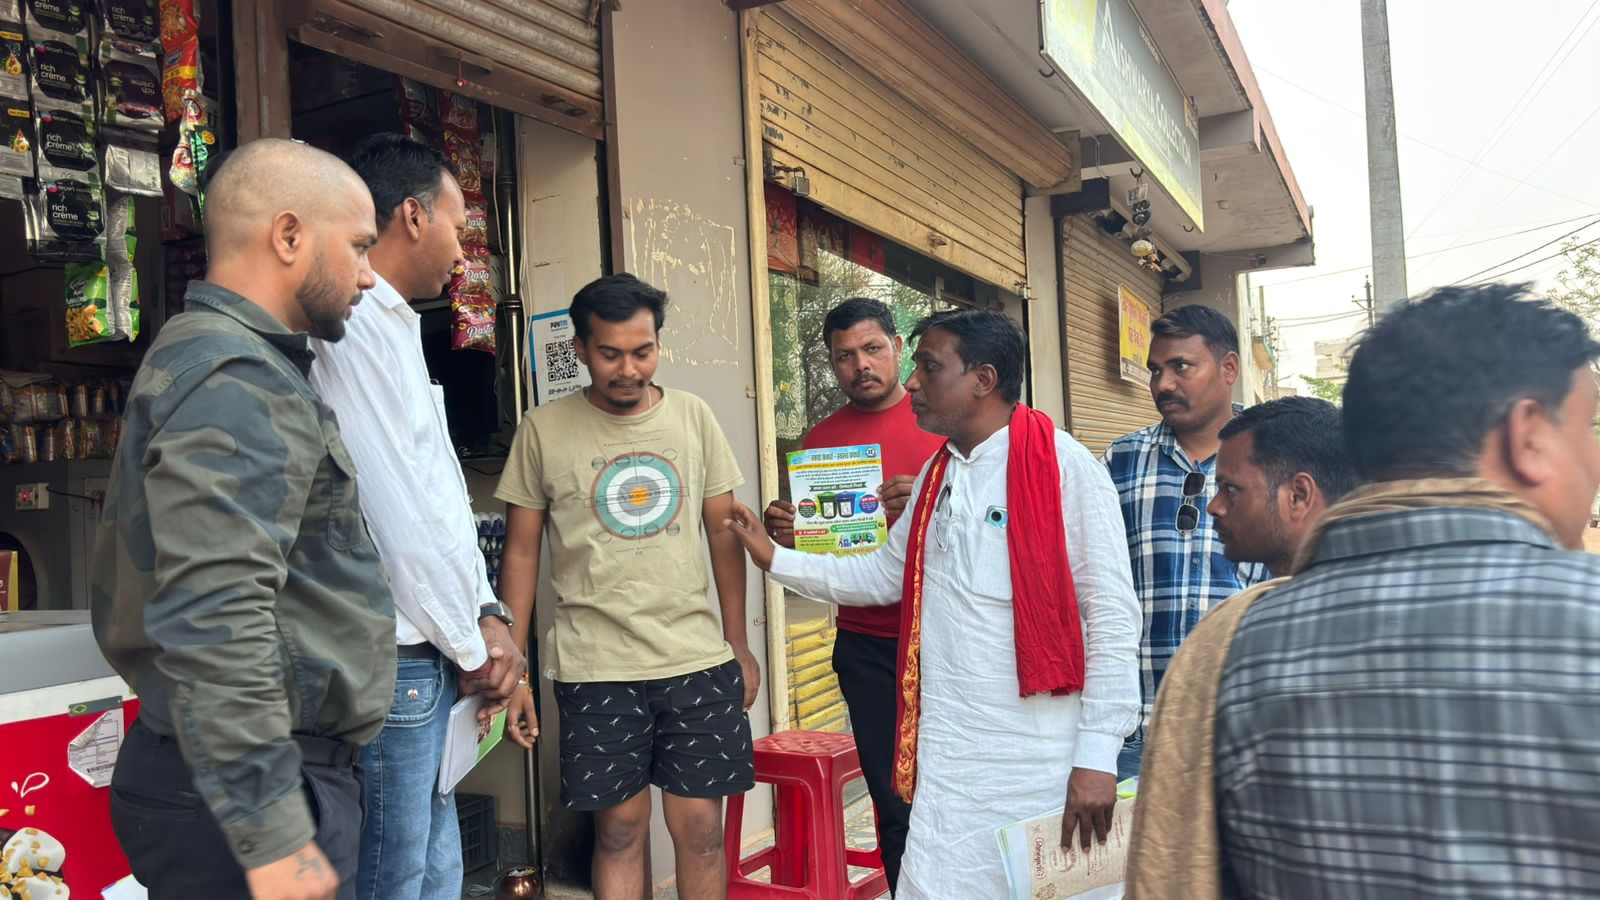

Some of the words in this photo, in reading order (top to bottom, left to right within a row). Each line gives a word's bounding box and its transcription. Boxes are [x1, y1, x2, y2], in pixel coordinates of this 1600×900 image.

[40, 63, 56, 73] rich
[46, 133, 62, 143] rich
[52, 203, 68, 212] rich
[465, 269, 490, 282] Pasta
[466, 323, 495, 338] Pasta
